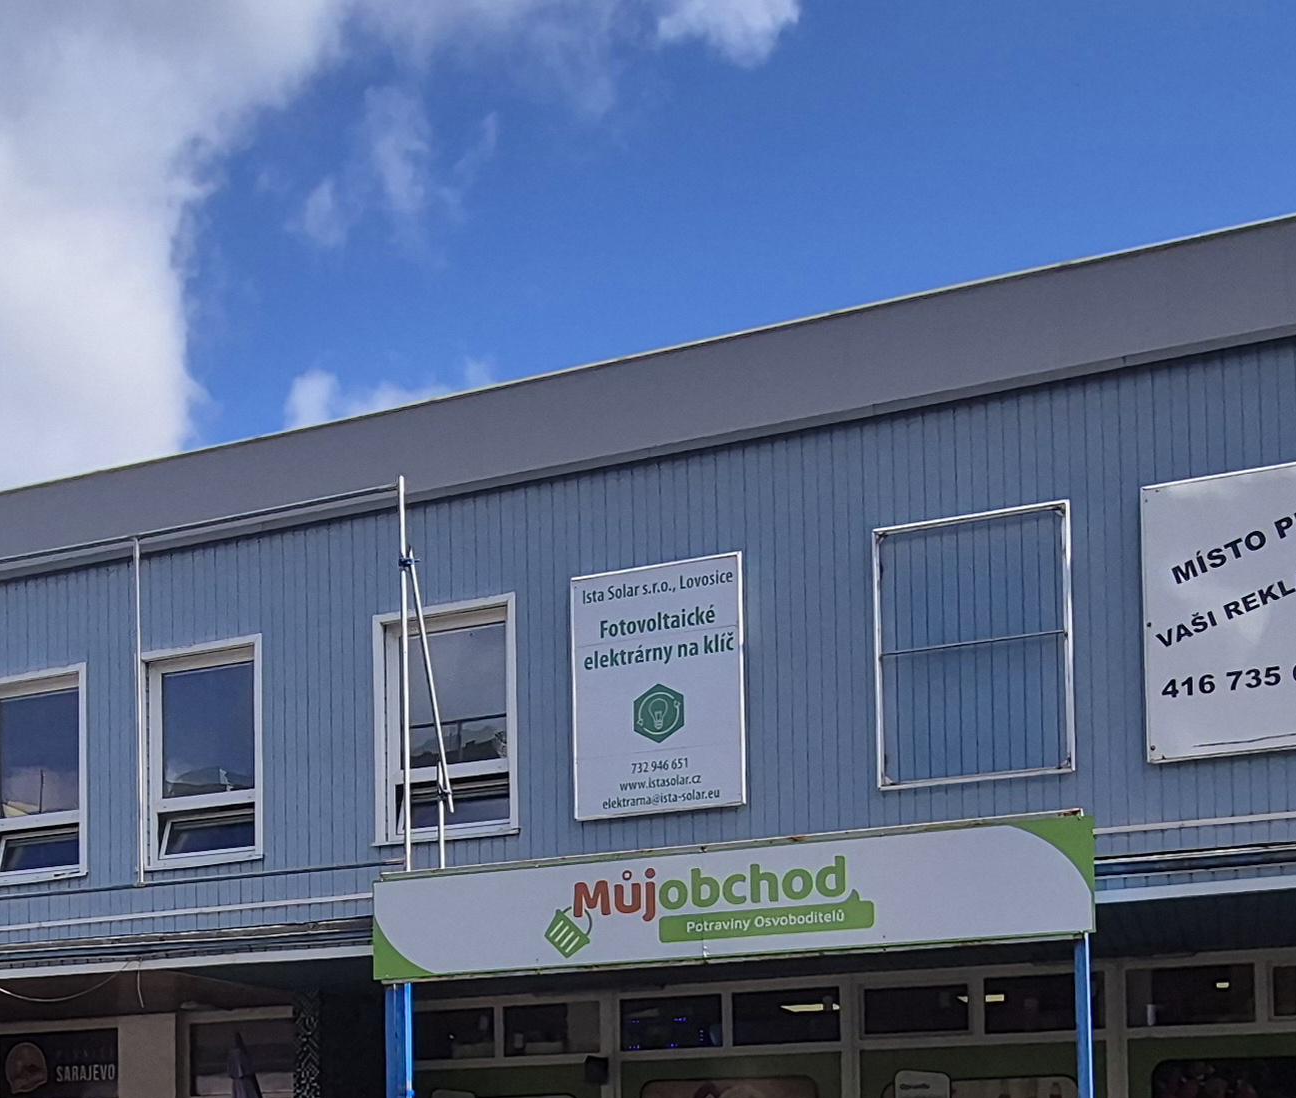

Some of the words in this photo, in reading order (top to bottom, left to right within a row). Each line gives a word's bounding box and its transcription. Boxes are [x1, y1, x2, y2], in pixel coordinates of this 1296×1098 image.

[1171, 530, 1266, 584] MÍSTO
[582, 590, 604, 604] Ista
[608, 584, 640, 600] Solar
[642, 580, 676, 596] s.r.o.,
[680, 570, 733, 590] Lovosice
[600, 604, 715, 638] Fotovoltaické
[1156, 610, 1218, 648] VAŠI
[584, 644, 673, 670] elektrárny
[678, 642, 698, 658] na
[704, 632, 734, 654] klíč
[1161, 673, 1216, 698] 416
[1226, 666, 1281, 690] 735
[631, 762, 649, 774] 732
[651, 760, 669, 772] 946
[671, 757, 689, 770] 651
[619, 774, 702, 791] www.istasolar.cz
[686, 913, 750, 933] Potraviny
[754, 908, 845, 929] Osvoboditelů
[56, 1064, 115, 1082] SARAJEVO
